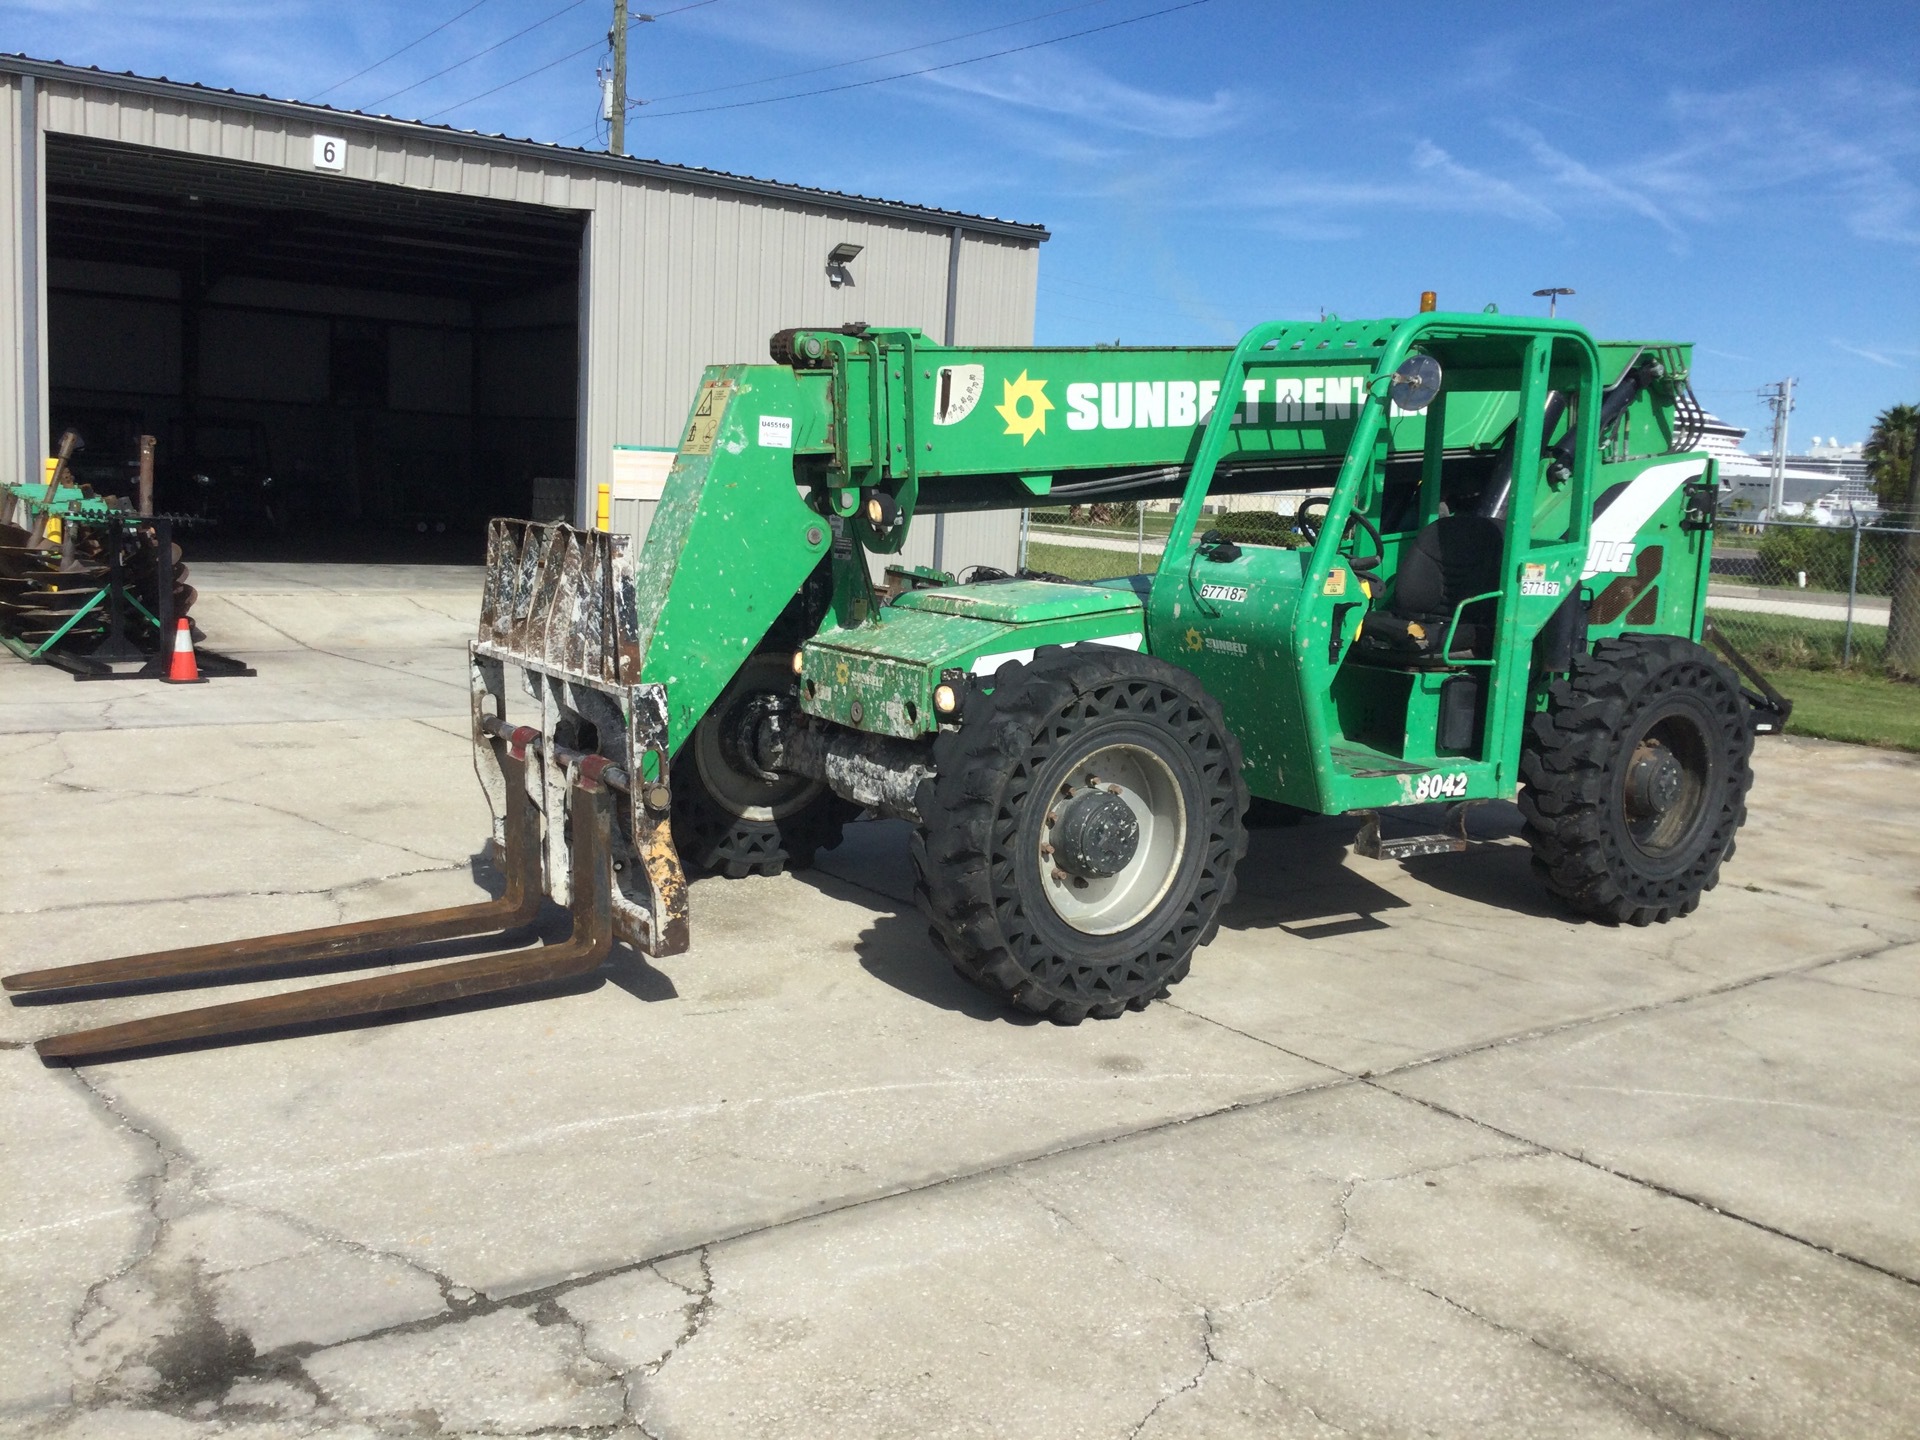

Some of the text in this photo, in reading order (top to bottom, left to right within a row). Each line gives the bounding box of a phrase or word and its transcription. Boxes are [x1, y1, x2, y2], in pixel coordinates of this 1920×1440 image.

[324, 141, 336, 163] 6
[1066, 380, 1265, 431] SUNBET
[761, 421, 790, 429] U455169
[1583, 541, 1637, 573] JLG
[1201, 585, 1247, 601] 677187
[1522, 581, 1559, 595] 677187
[1205, 638, 1248, 654] SUNBELT
[1415, 772, 1468, 799] 8042
